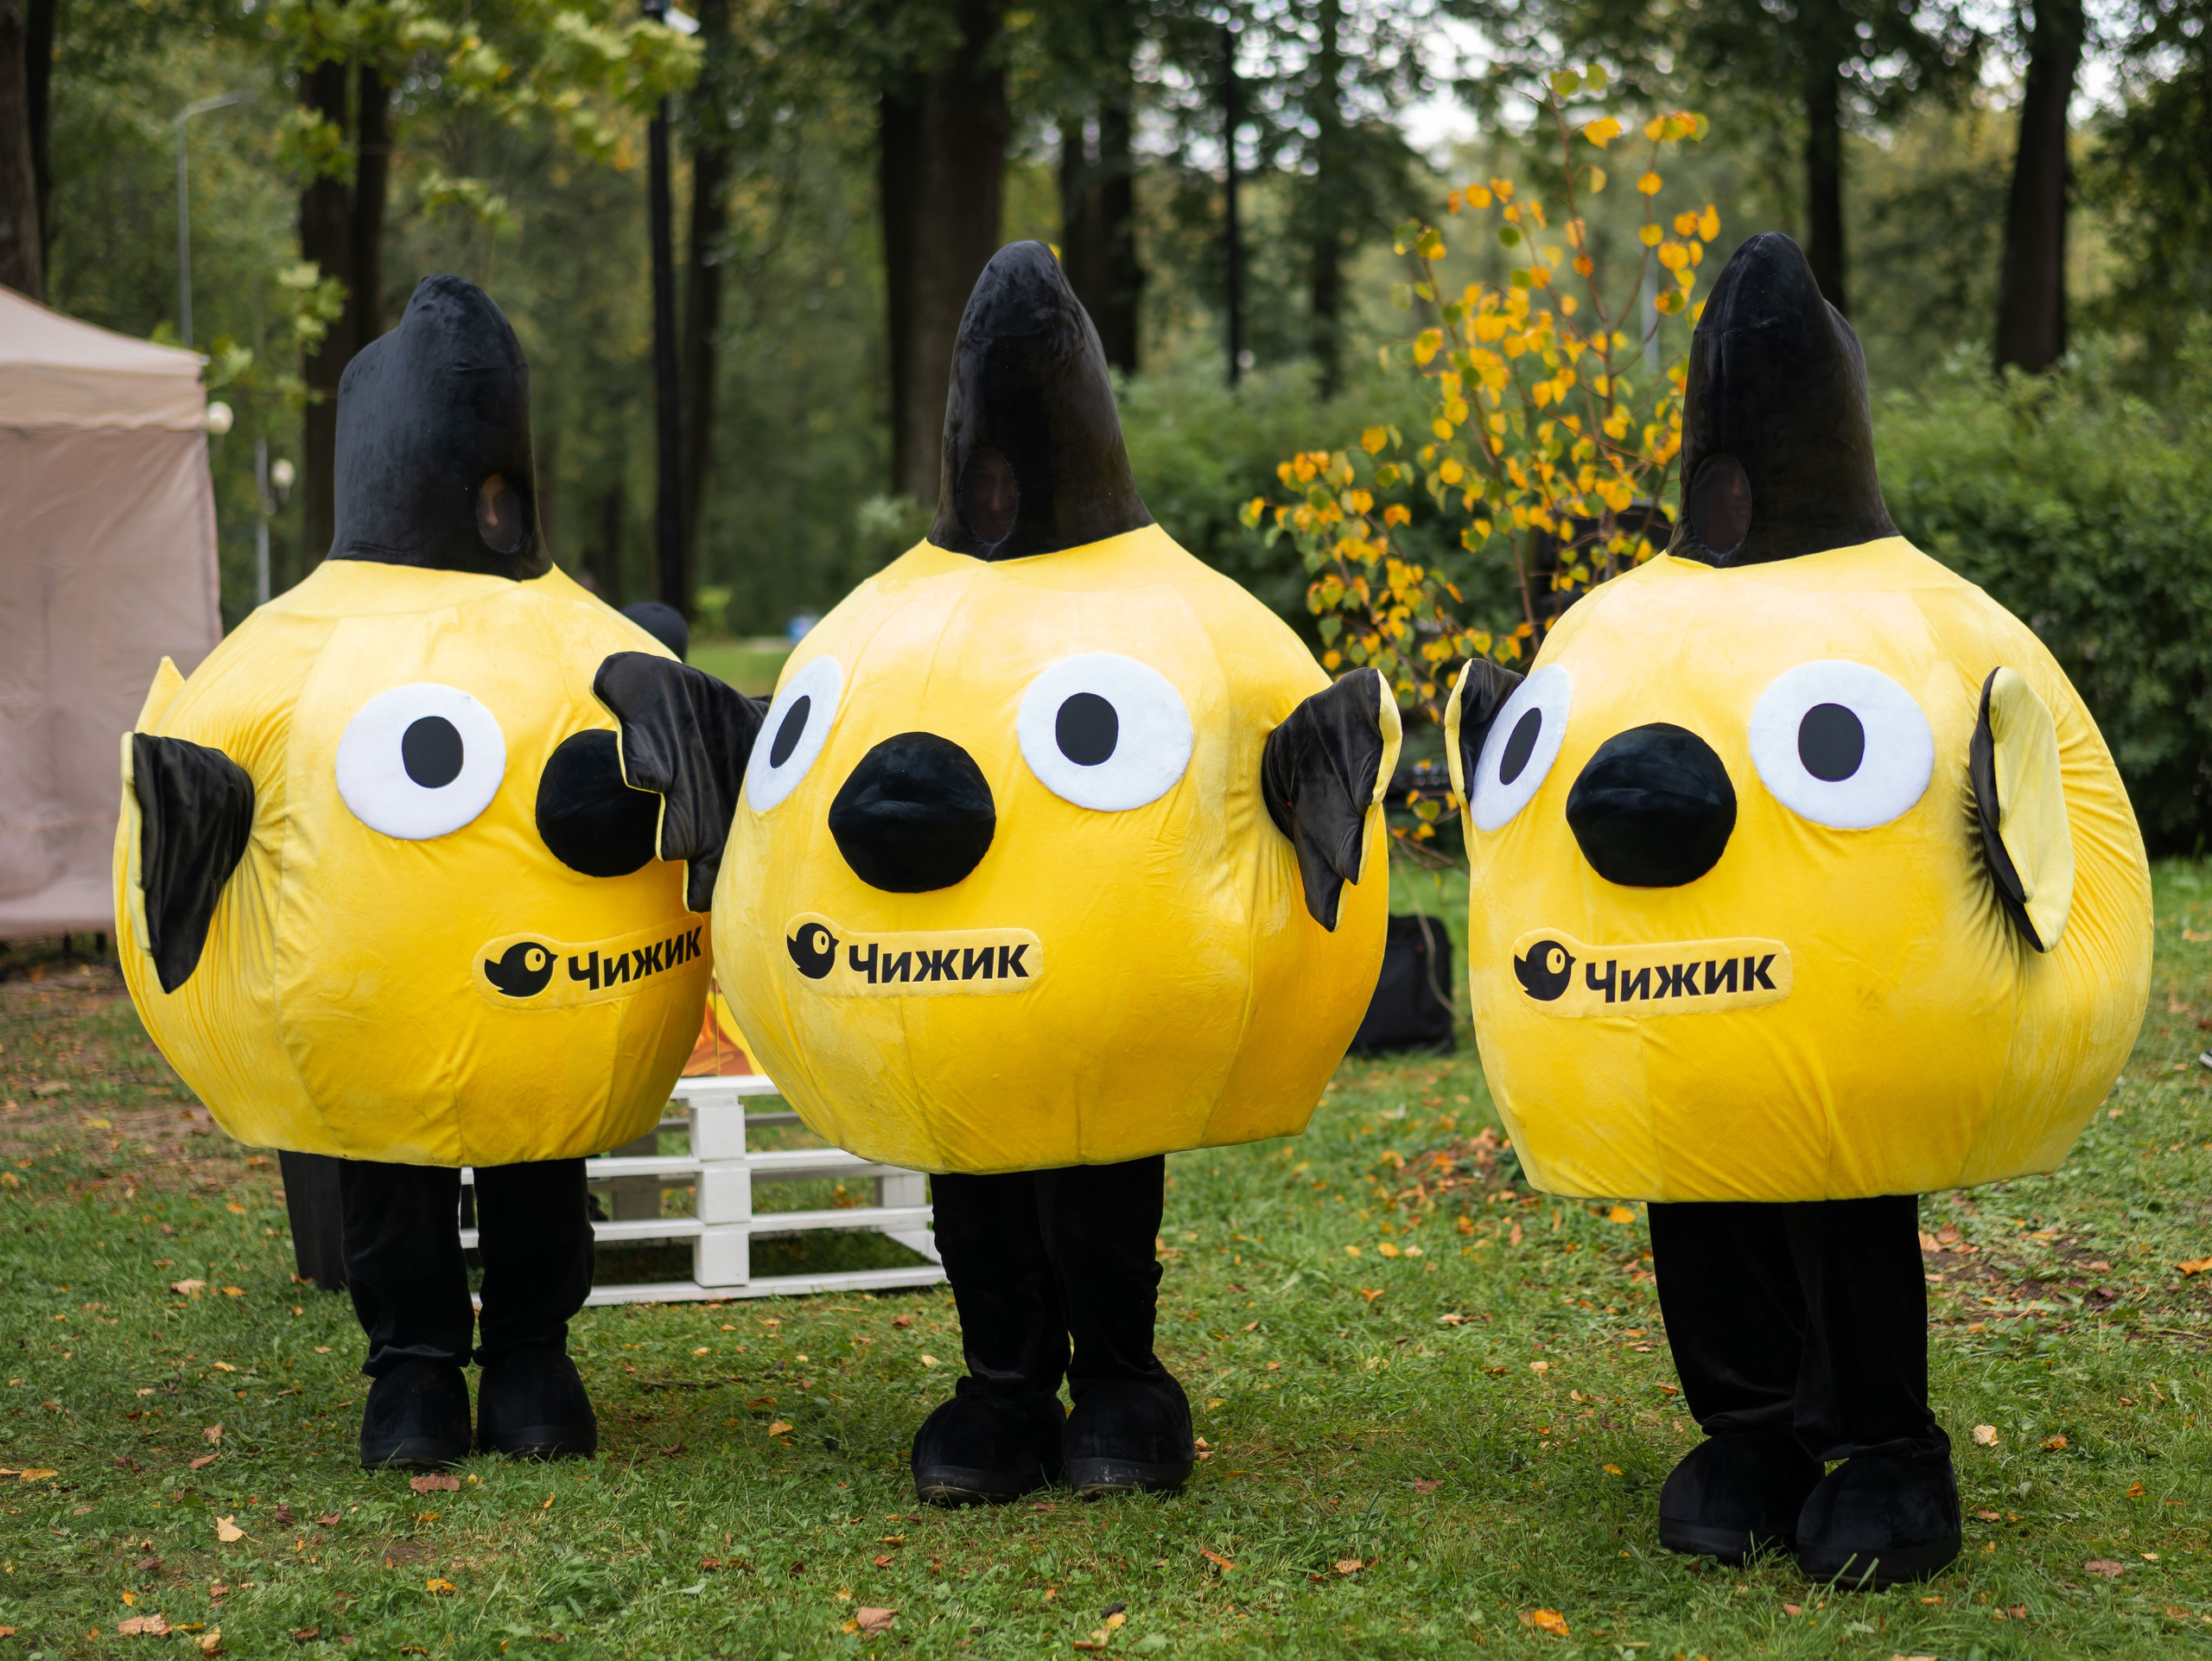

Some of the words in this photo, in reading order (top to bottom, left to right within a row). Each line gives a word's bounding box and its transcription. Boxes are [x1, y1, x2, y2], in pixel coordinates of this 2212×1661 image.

[569, 926, 702, 990] Чижик
[849, 944, 1030, 983] Чижик
[1586, 954, 1777, 1003] Чижик
